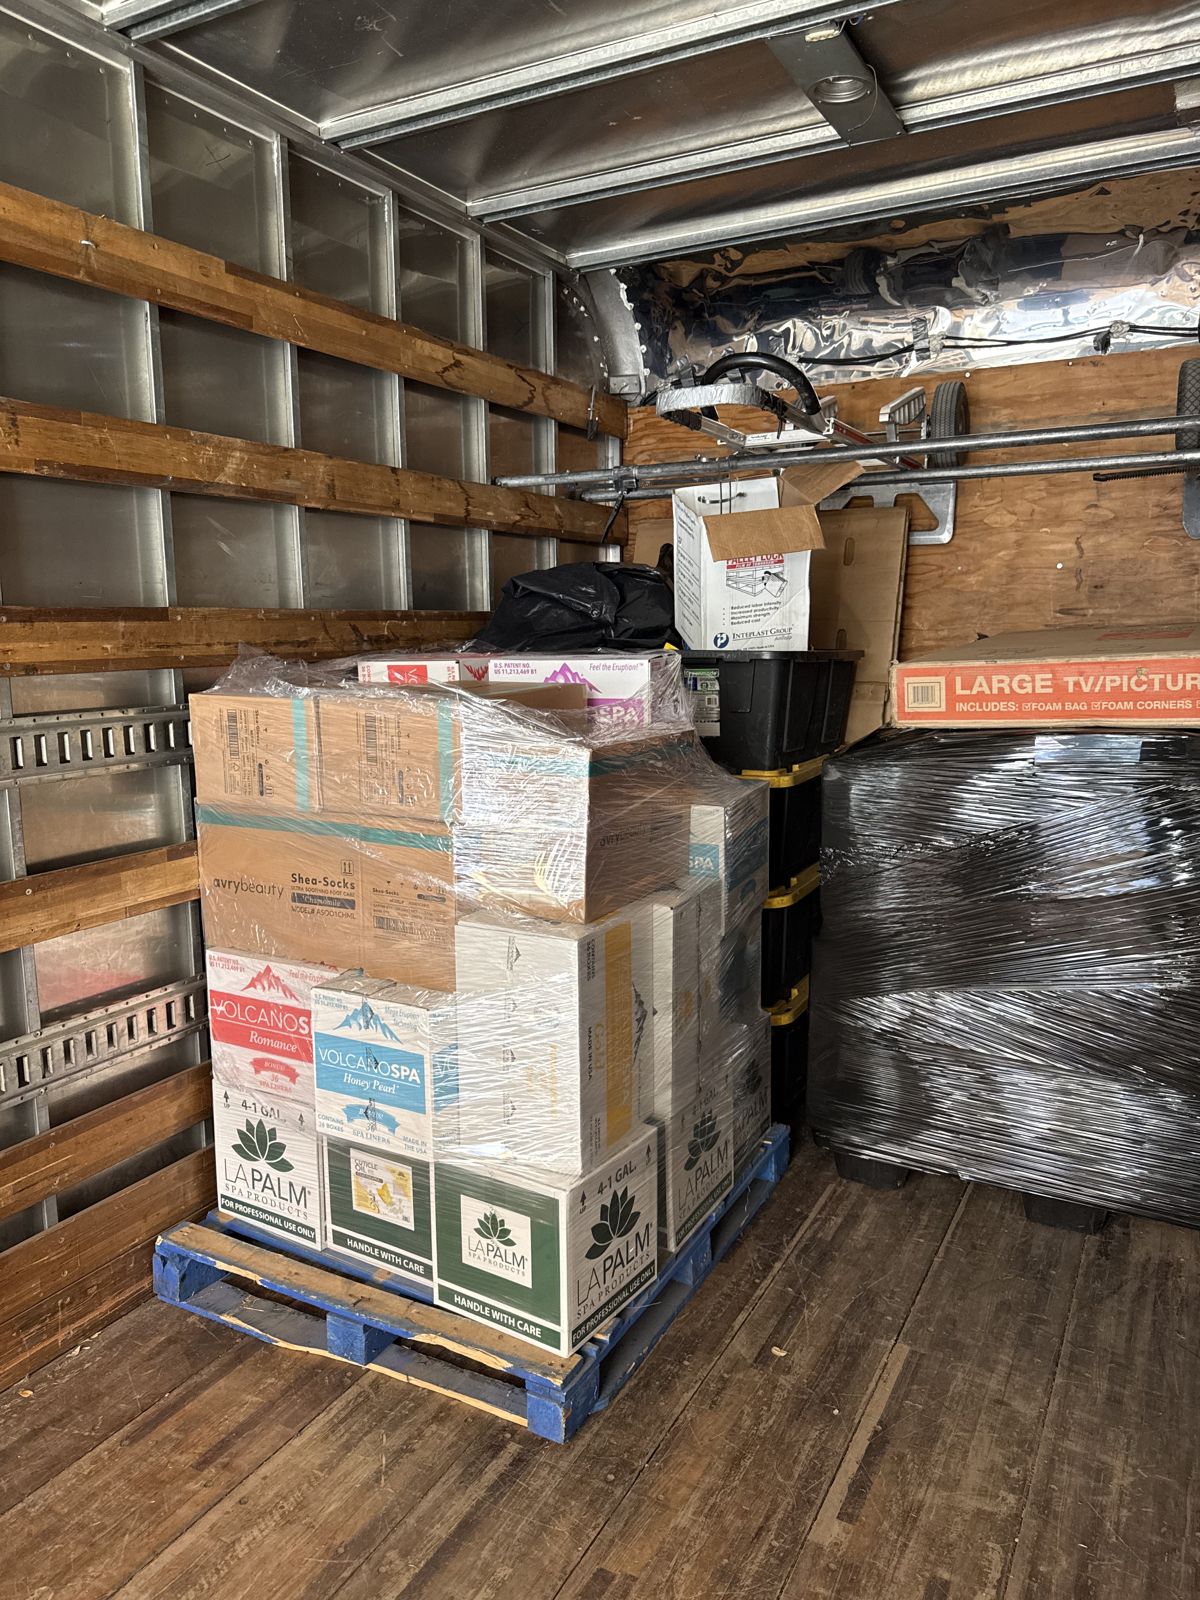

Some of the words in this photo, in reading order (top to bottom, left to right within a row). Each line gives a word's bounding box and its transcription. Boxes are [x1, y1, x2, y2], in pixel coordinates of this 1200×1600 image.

[589, 663, 600, 671] Feel
[600, 663, 611, 671] the
[955, 674, 1053, 695] LARGE
[955, 702, 1019, 712] INCLUDES:
[1032, 702, 1062, 711] FOAM
[1065, 702, 1088, 711] BAG
[1102, 701, 1134, 711] FOAM
[1137, 700, 1193, 710] CORNERS
[213, 877, 284, 898] avrybeauty
[291, 872, 356, 890] Shea-Socks
[249, 1030, 297, 1053] Romance
[319, 1047, 421, 1084] VOLCANOSPA
[343, 1072, 371, 1090] Honey
[373, 1079, 396, 1094] Pearl
[242, 1099, 257, 1114] 4-1
[224, 1158, 250, 1189] LA
[251, 1167, 307, 1210] PALM
[597, 1175, 612, 1195] 4-1
[615, 1160, 637, 1183] GAL.
[221, 1197, 235, 1209] FOR
[235, 1203, 283, 1227] PROFESSIONAL
[283, 1221, 296, 1233] USE
[297, 1226, 315, 1239] ONLY
[225, 1183, 243, 1197] SPA
[247, 1191, 309, 1221] PRODUCTS
[579, 1205, 587, 1214] UP
[347, 1238, 380, 1256] HANDLE
[380, 1250, 402, 1265] WITH
[403, 1259, 425, 1275] CARE
[468, 1235, 485, 1255] LA
[486, 1242, 526, 1270] PALM
[468, 1252, 482, 1262] SPA
[483, 1257, 526, 1277] PRODUCTS
[577, 1267, 601, 1307] LA
[602, 1222, 650, 1285] PALM
[577, 1300, 596, 1320] SPA
[597, 1253, 651, 1303] PRODUCTS
[454, 1294, 491, 1317] HANDLE
[491, 1309, 516, 1327] WITH
[517, 1319, 542, 1338] CARE
[573, 1325, 586, 1343] FOR
[586, 1289, 629, 1331] PROFESSIONAL
[629, 1278, 640, 1294] USE
[640, 1266, 655, 1283] ONLY
